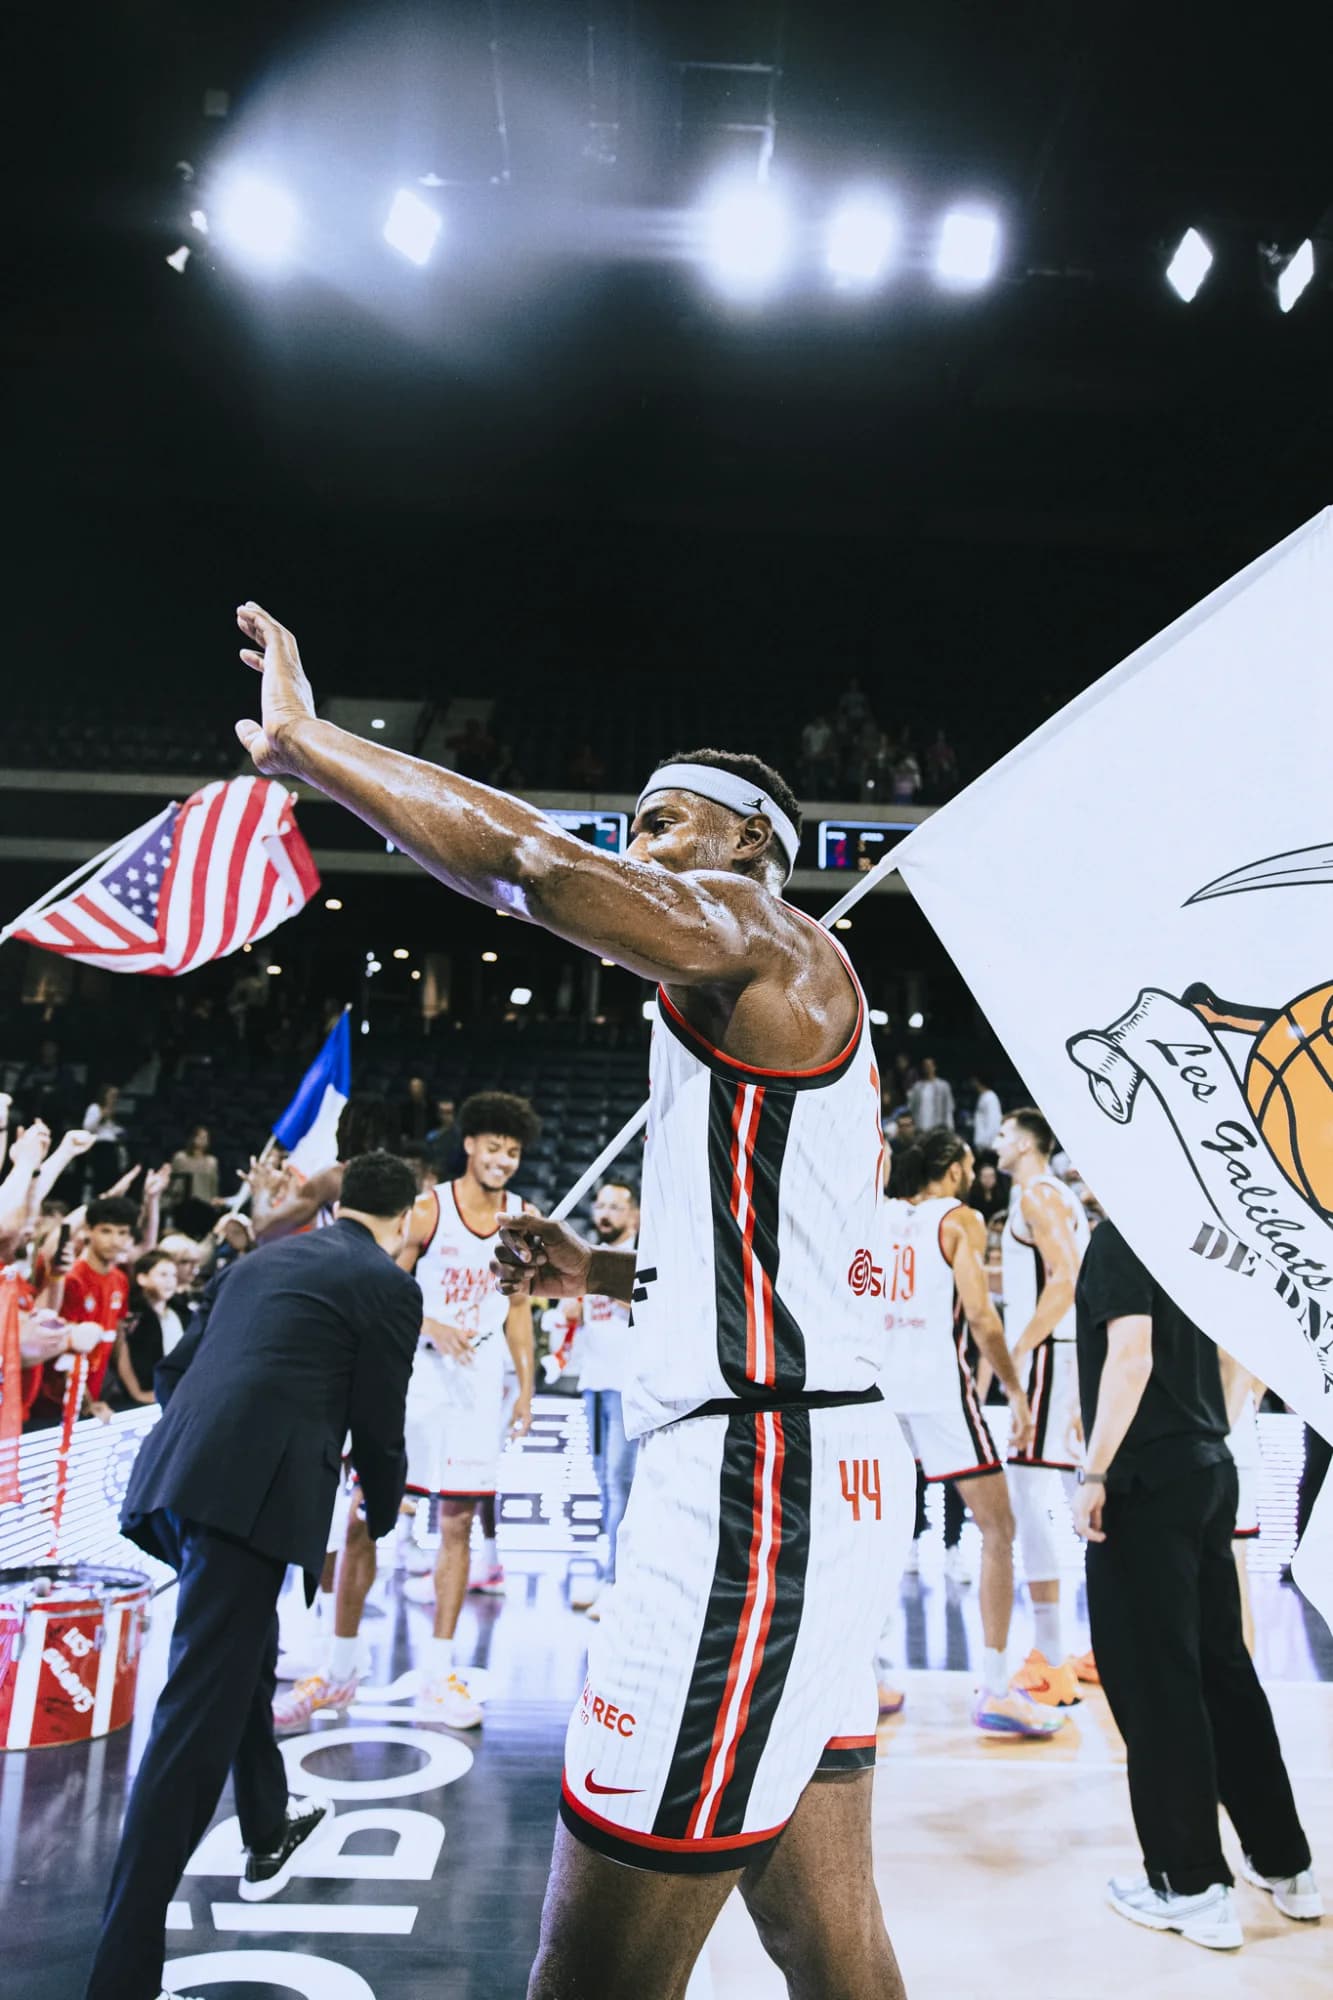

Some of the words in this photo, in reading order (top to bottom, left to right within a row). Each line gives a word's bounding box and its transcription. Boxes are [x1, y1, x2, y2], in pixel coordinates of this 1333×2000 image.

[1146, 1039, 1217, 1103] Les
[1201, 1120, 1333, 1288] Galibots
[1188, 1221, 1261, 1277] DE
[839, 1459, 881, 1521] 44
